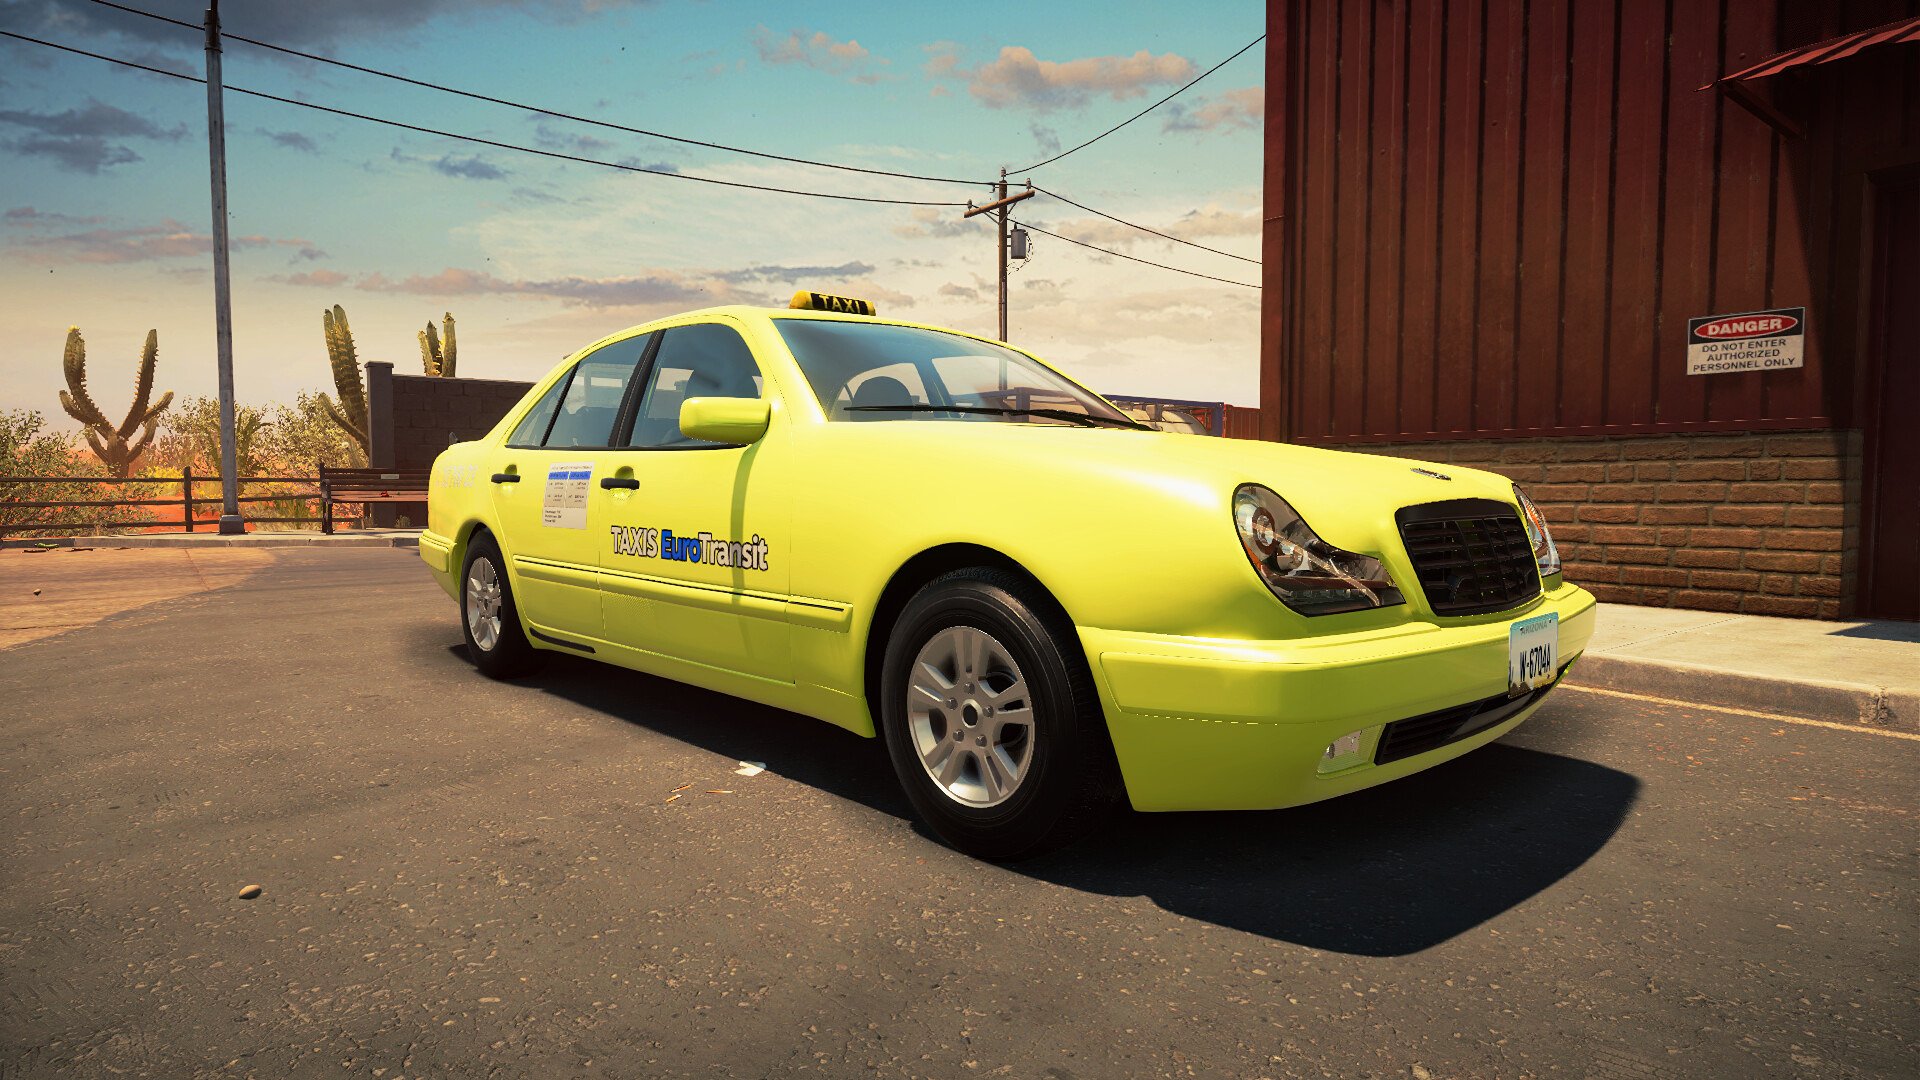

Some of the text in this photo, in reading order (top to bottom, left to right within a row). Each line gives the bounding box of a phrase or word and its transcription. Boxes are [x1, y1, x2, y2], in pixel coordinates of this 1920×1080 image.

[819, 294, 861, 314] TAXI
[1707, 319, 1782, 336] DANGER
[1702, 338, 1787, 353] DO NOT ENTER
[1707, 349, 1780, 362] AUTHORIZED
[1693, 357, 1796, 373] PERSONNEL ONLY
[611, 525, 658, 558] TAXIS
[1520, 621, 1548, 636] ARIZONA
